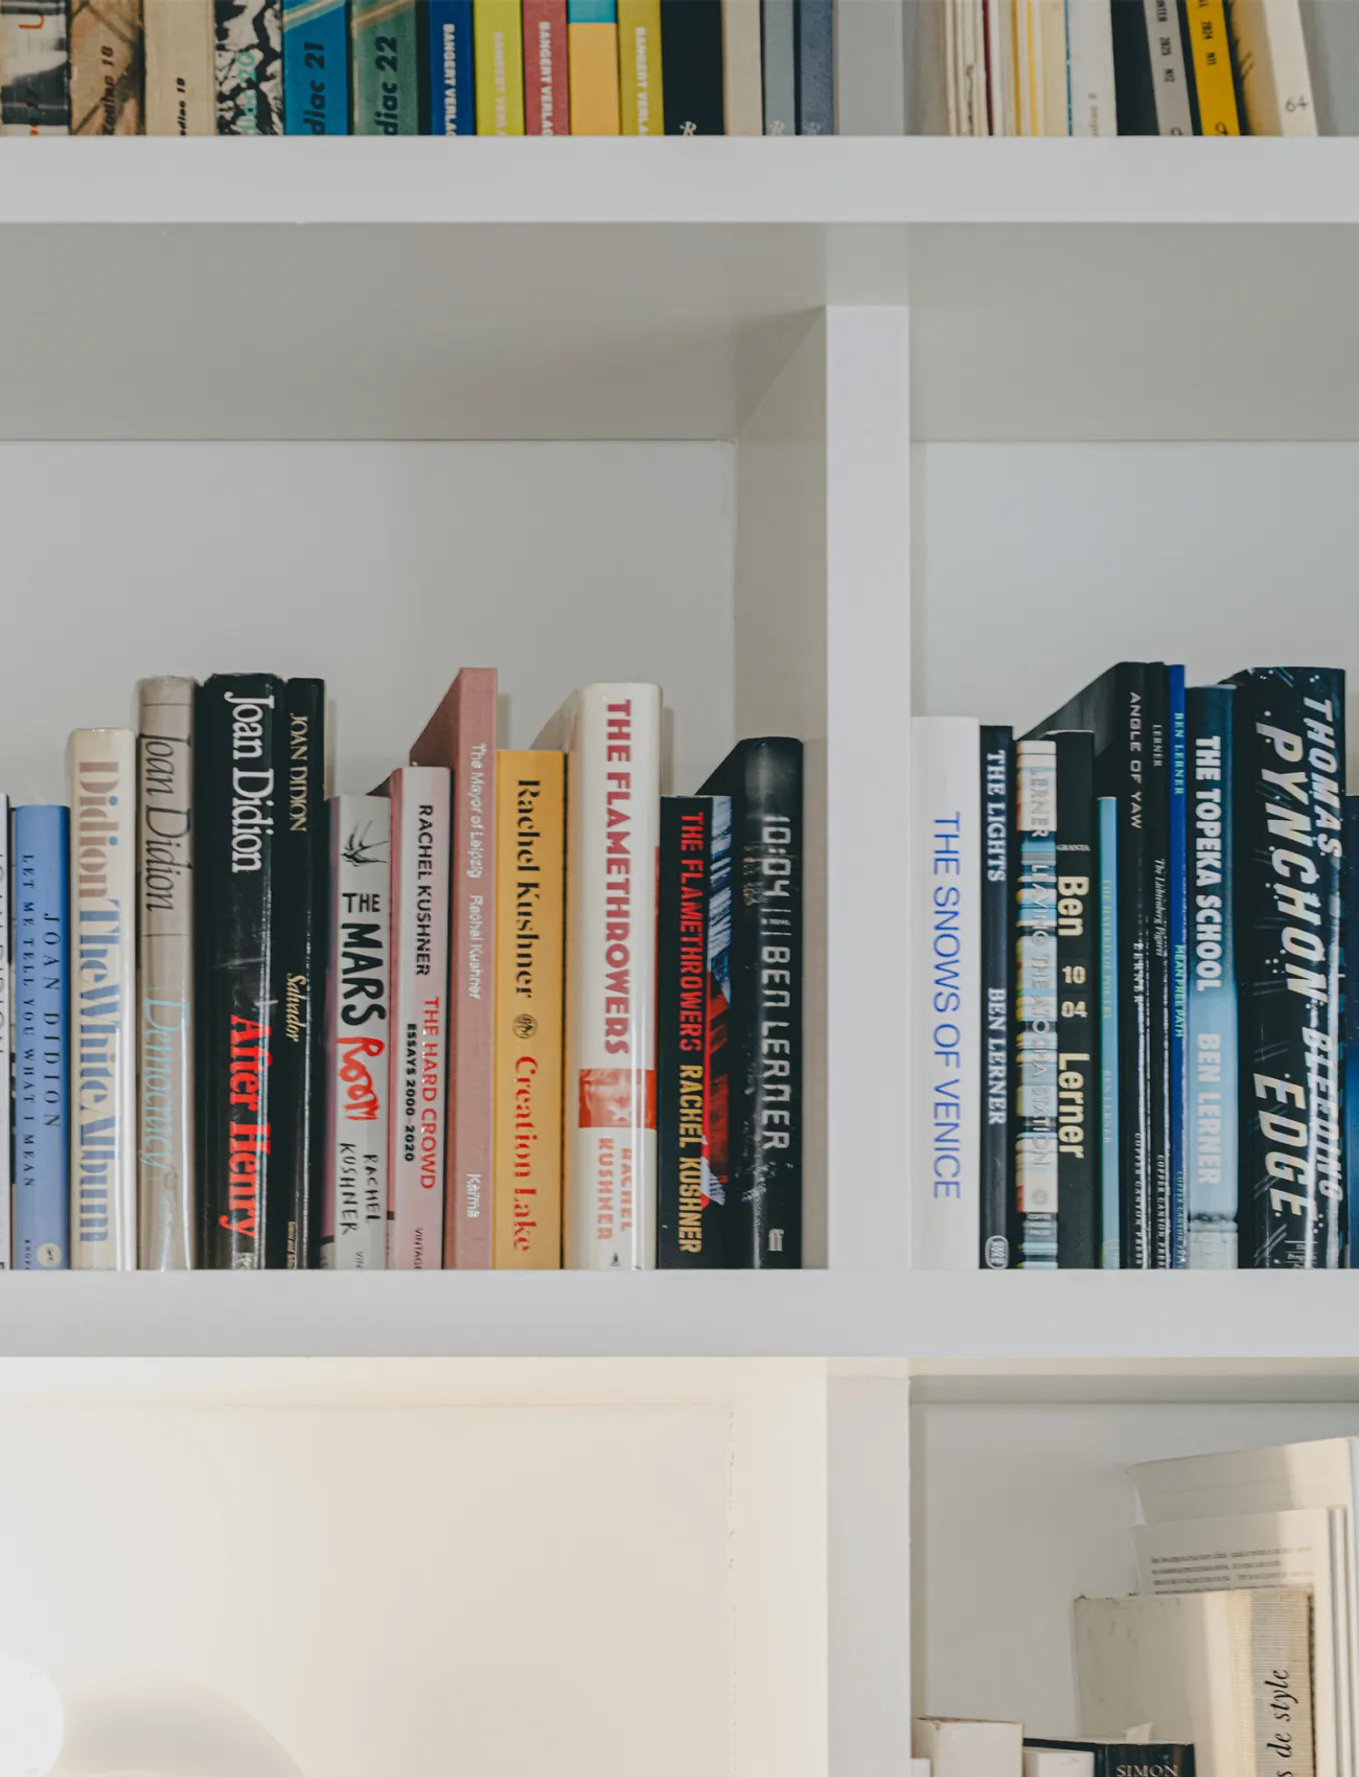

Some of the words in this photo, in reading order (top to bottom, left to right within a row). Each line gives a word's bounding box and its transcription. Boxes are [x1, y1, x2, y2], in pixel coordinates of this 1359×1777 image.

[304, 42, 325, 71] 21
[374, 36, 397, 72] 22
[225, 692, 275, 756] Joan
[1196, 735, 1221, 780] THE
[987, 750, 1006, 796] THE
[1304, 697, 1343, 857] THOMAS
[231, 768, 276, 872] Didion
[934, 812, 962, 877] THE
[987, 803, 1006, 882] LIGHTS
[1196, 788, 1221, 887] TOPEKA
[1255, 721, 1330, 1005] PYNCHON
[343, 893, 381, 913] THE
[1058, 876, 1089, 936] Ben
[341, 922, 386, 1027] MARS
[933, 886, 962, 1013] SNOWS
[1195, 894, 1221, 992] SCHOOL
[423, 997, 440, 1036] THE
[933, 1023, 962, 1068] OF
[229, 1016, 272, 1111] After
[422, 1042, 440, 1103] HARD
[513, 1056, 539, 1180] Creation
[933, 1078, 962, 1200] VENICE
[1058, 1052, 1089, 1158] Lerner
[1302, 1026, 1343, 1200] BLEEDING
[219, 1120, 271, 1239] Henry
[419, 1108, 438, 1189] CROWD
[1253, 1073, 1316, 1219] EDGE
[513, 1188, 538, 1252] Lake
[1265, 1668, 1294, 1722] style
[1118, 1763, 1179, 1777] SIMON
[1268, 1729, 1291, 1760] de
